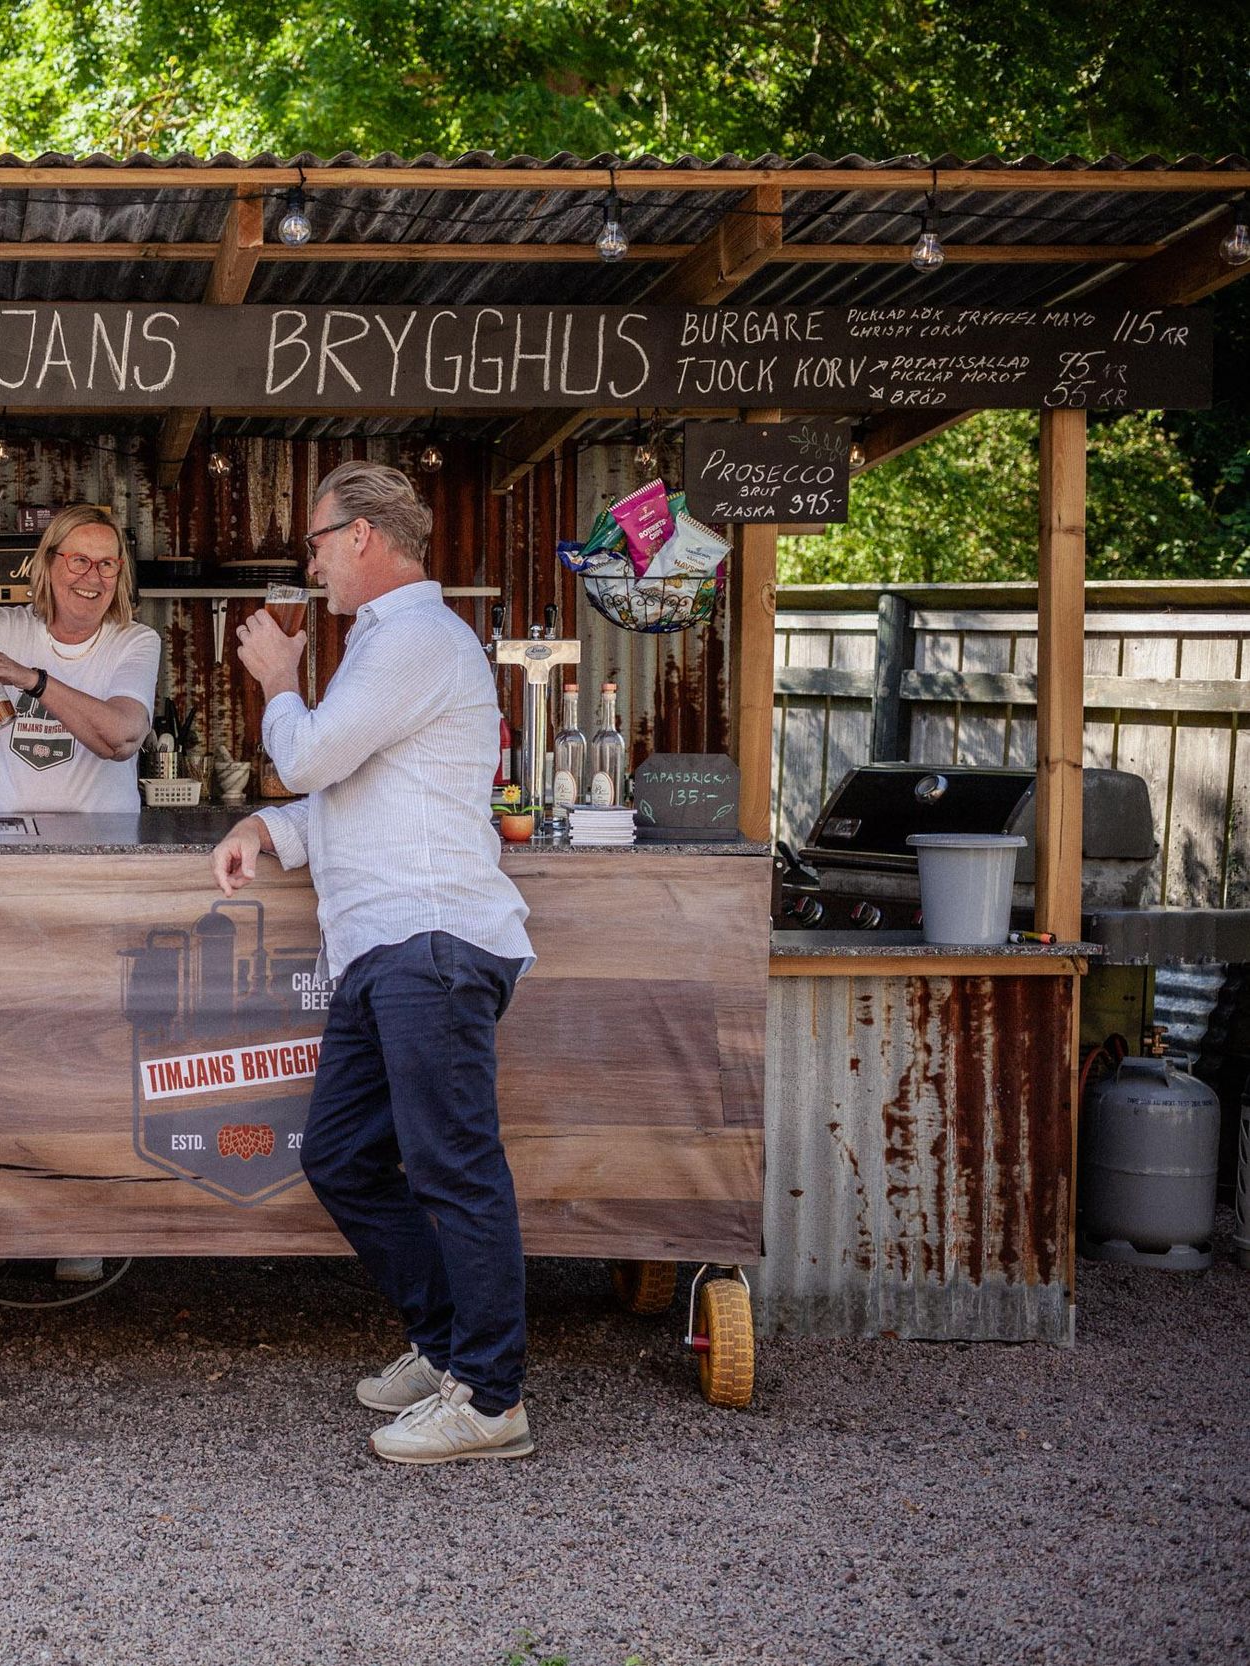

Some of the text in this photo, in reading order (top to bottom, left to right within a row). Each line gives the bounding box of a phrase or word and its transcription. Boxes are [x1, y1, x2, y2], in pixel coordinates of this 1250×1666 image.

[680, 307, 1188, 346] BURGARE PICKLAD LÖK TRYFFEL MAYO 115 KR
[849, 324, 968, 338] CHRISPY CORN
[266, 309, 649, 398] BRYGGHUS
[677, 356, 777, 393] TJOCK
[793, 356, 866, 388] KORV
[891, 355, 1030, 369] POTATISSALLAD
[1058, 350, 1106, 380] 95
[960, 370, 1027, 383] MOROT
[889, 380, 1127, 407] BRÖD 55 KR
[700, 449, 835, 484] PROSECCO
[739, 485, 782, 497] BRUT
[711, 502, 775, 518] FLASKA
[147, 1055, 236, 1093] TIMJANS
[171, 1134, 207, 1150] ESTD.
